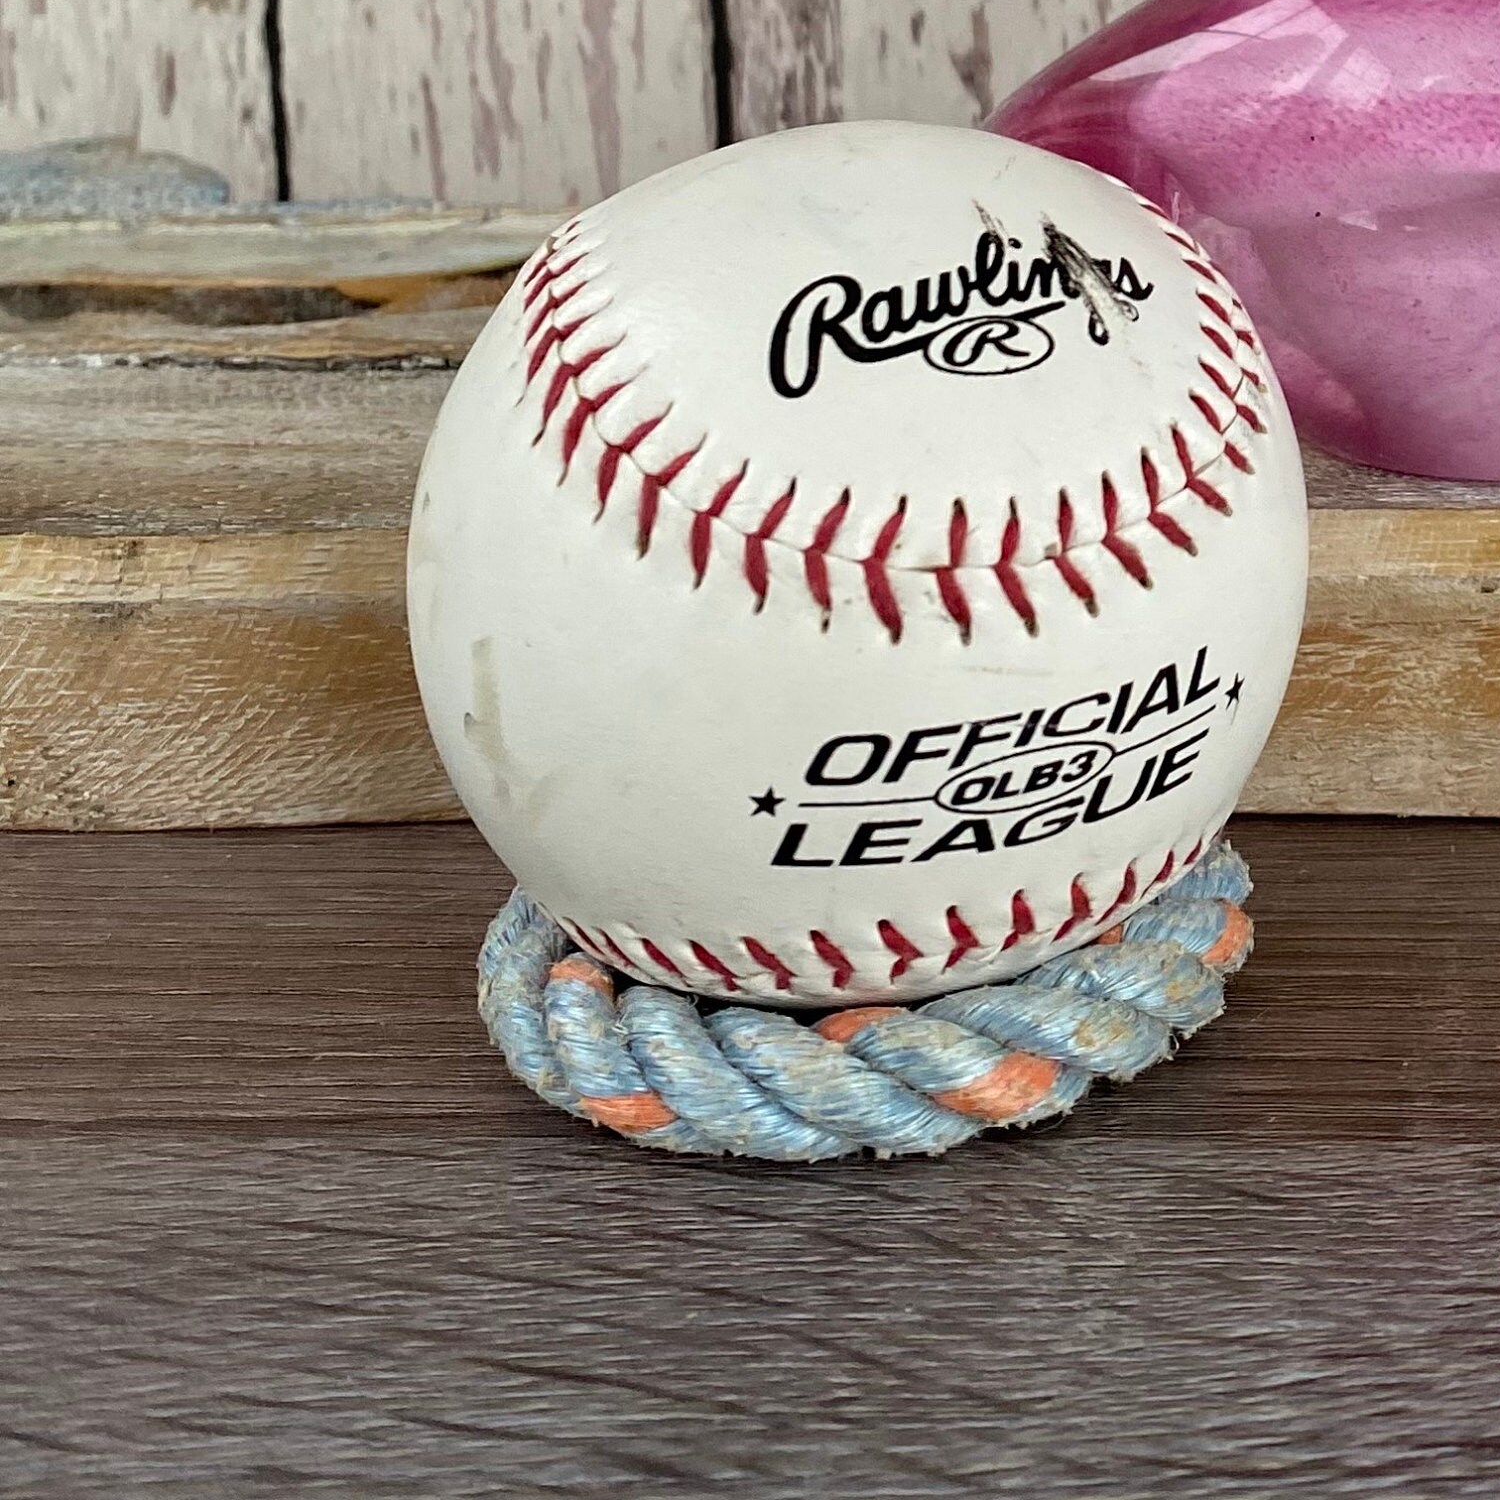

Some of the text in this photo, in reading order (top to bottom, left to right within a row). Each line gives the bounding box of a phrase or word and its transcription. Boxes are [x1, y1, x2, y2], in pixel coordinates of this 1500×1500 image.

[804, 645, 1222, 787] OFFICIAL
[950, 752, 1098, 806] OLB3
[770, 727, 1210, 868] LEAGUE
